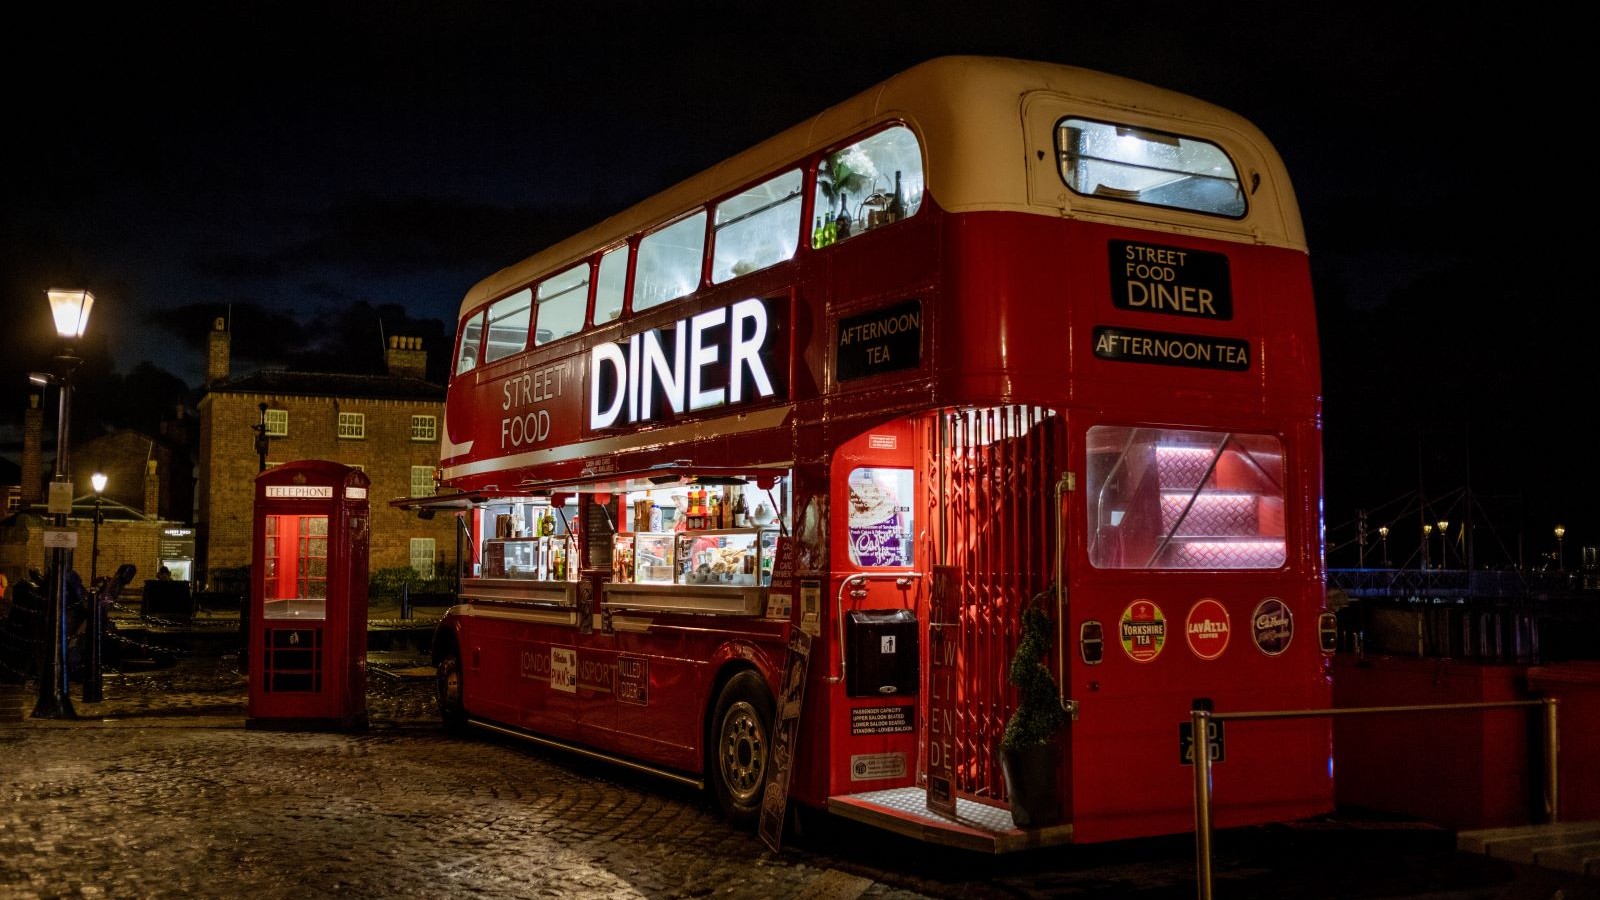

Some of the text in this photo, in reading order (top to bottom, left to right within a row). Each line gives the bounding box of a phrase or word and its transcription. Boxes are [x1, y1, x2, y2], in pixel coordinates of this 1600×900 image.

[1125, 245, 1187, 266] STREET
[1126, 263, 1175, 282] FOOD
[1127, 280, 1217, 315] DINER
[840, 311, 919, 346] AFTERNOON
[866, 345, 890, 365] TEA
[1096, 335, 1248, 365] AFTERNOON TEA
[590, 297, 775, 431] DINER
[502, 363, 566, 410] STREET
[501, 410, 550, 449] FOOD
[269, 487, 331, 497] TELEPHONE
[1123, 624, 1163, 636] YORKSHIRE
[1188, 619, 1228, 633] LAVAZZA
[1136, 635, 1151, 645] TEA
[521, 651, 551, 676] LONDO
[577, 658, 618, 692] NSPORT
[619, 660, 640, 679] MULLED
[931, 573, 945, 767] MULLED
[622, 681, 638, 699] CIDER
[943, 641, 956, 770] WINE
[1186, 722, 1217, 741] JD
